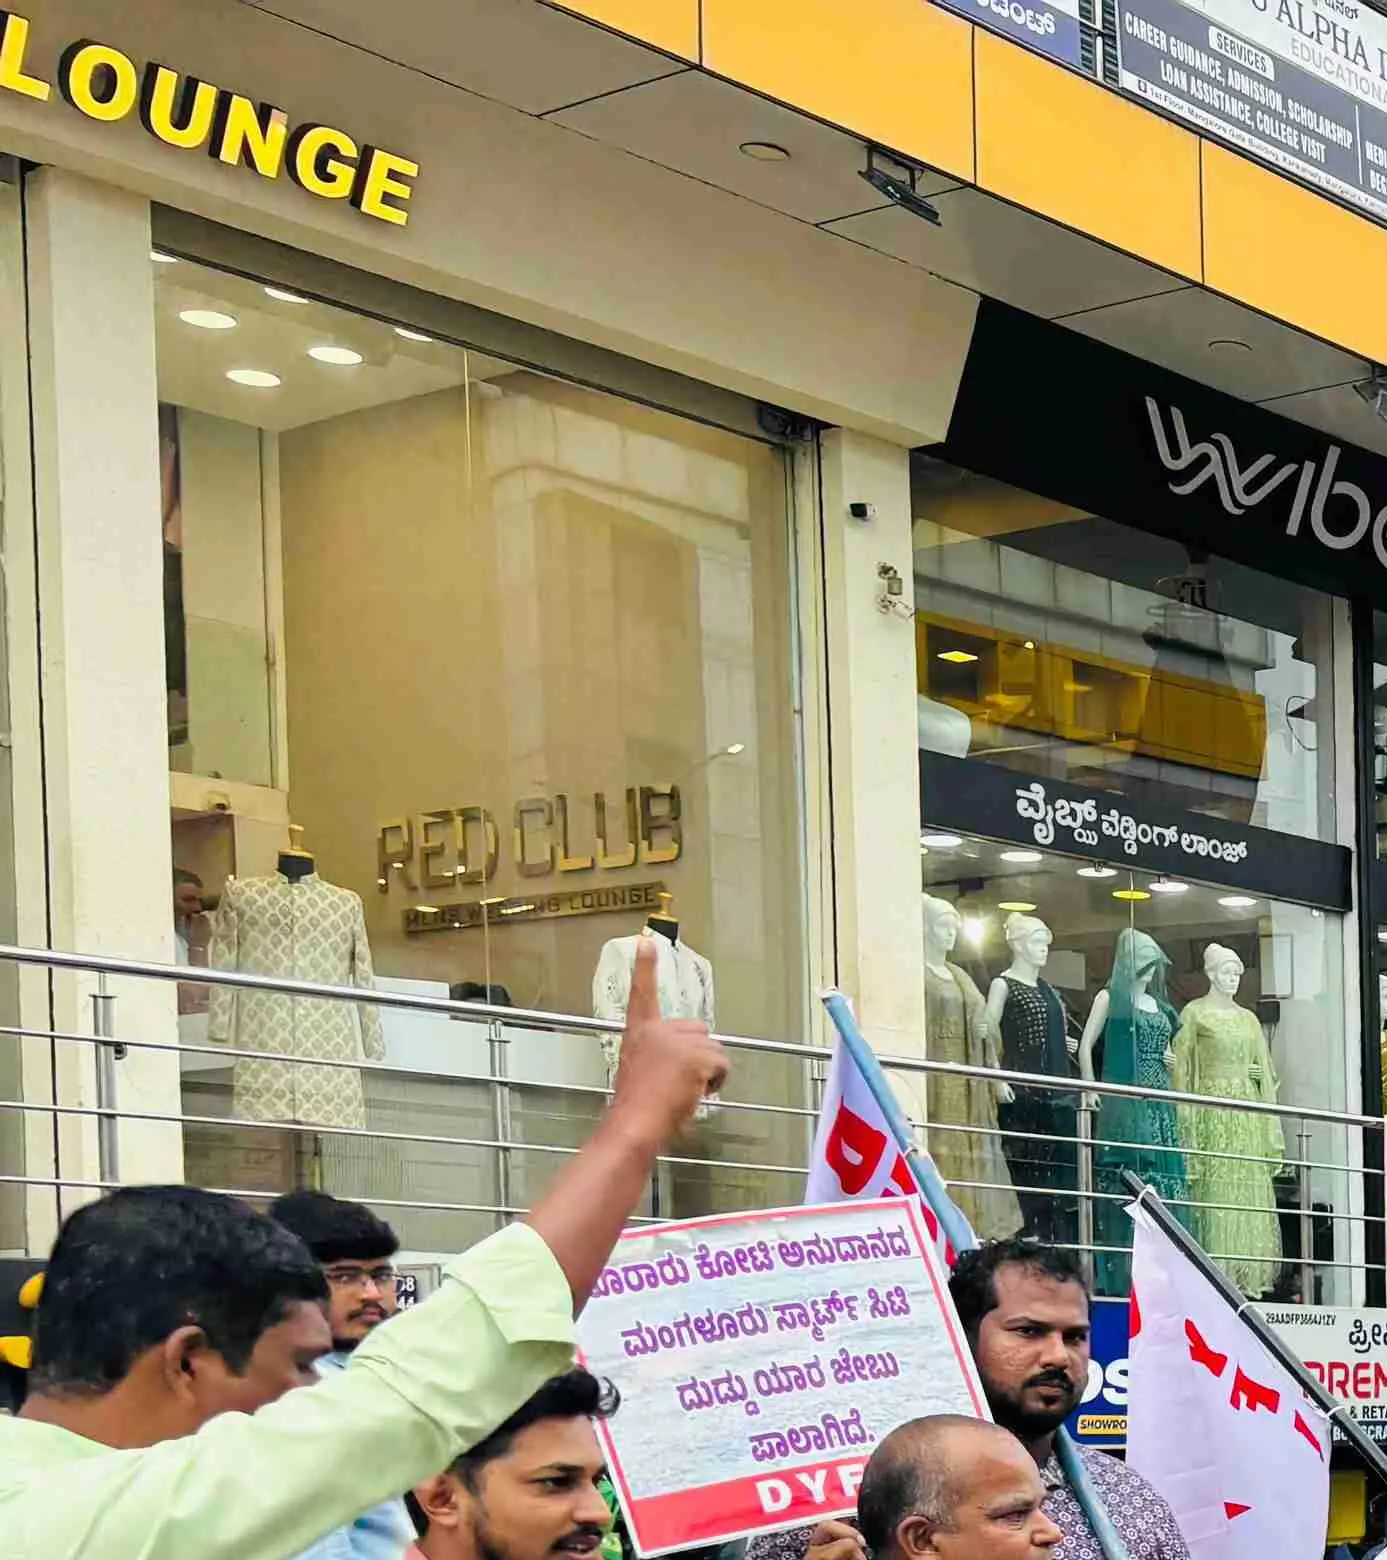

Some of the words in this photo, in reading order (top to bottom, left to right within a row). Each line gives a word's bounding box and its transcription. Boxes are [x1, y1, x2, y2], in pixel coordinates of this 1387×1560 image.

[1125, 12, 1168, 53] CAREER
[1216, 33, 1267, 74] SERVICES
[1276, 0, 1370, 73] ALPHA
[0, 14, 420, 226] LOUNGE
[1256, 110, 1299, 152] COLLEGE
[1300, 135, 1327, 164] VISIT
[376, 806, 500, 894] RED
[513, 783, 683, 879] CLUB
[694, 1241, 776, 1281] ಕೋಟಿ
[777, 1225, 912, 1268] ಅನುದಾನದ
[620, 1301, 770, 1358] ಮಂಗಳೂರು
[866, 1285, 912, 1319] ಸಿಟಿ
[676, 1367, 761, 1417] ದುಡ್ಡು
[754, 1360, 827, 1398] ಯಾರ
[829, 1346, 901, 1384] ಜೇಬು
[748, 1408, 876, 1464] ಪಾಲಾಗಿದೆ.
